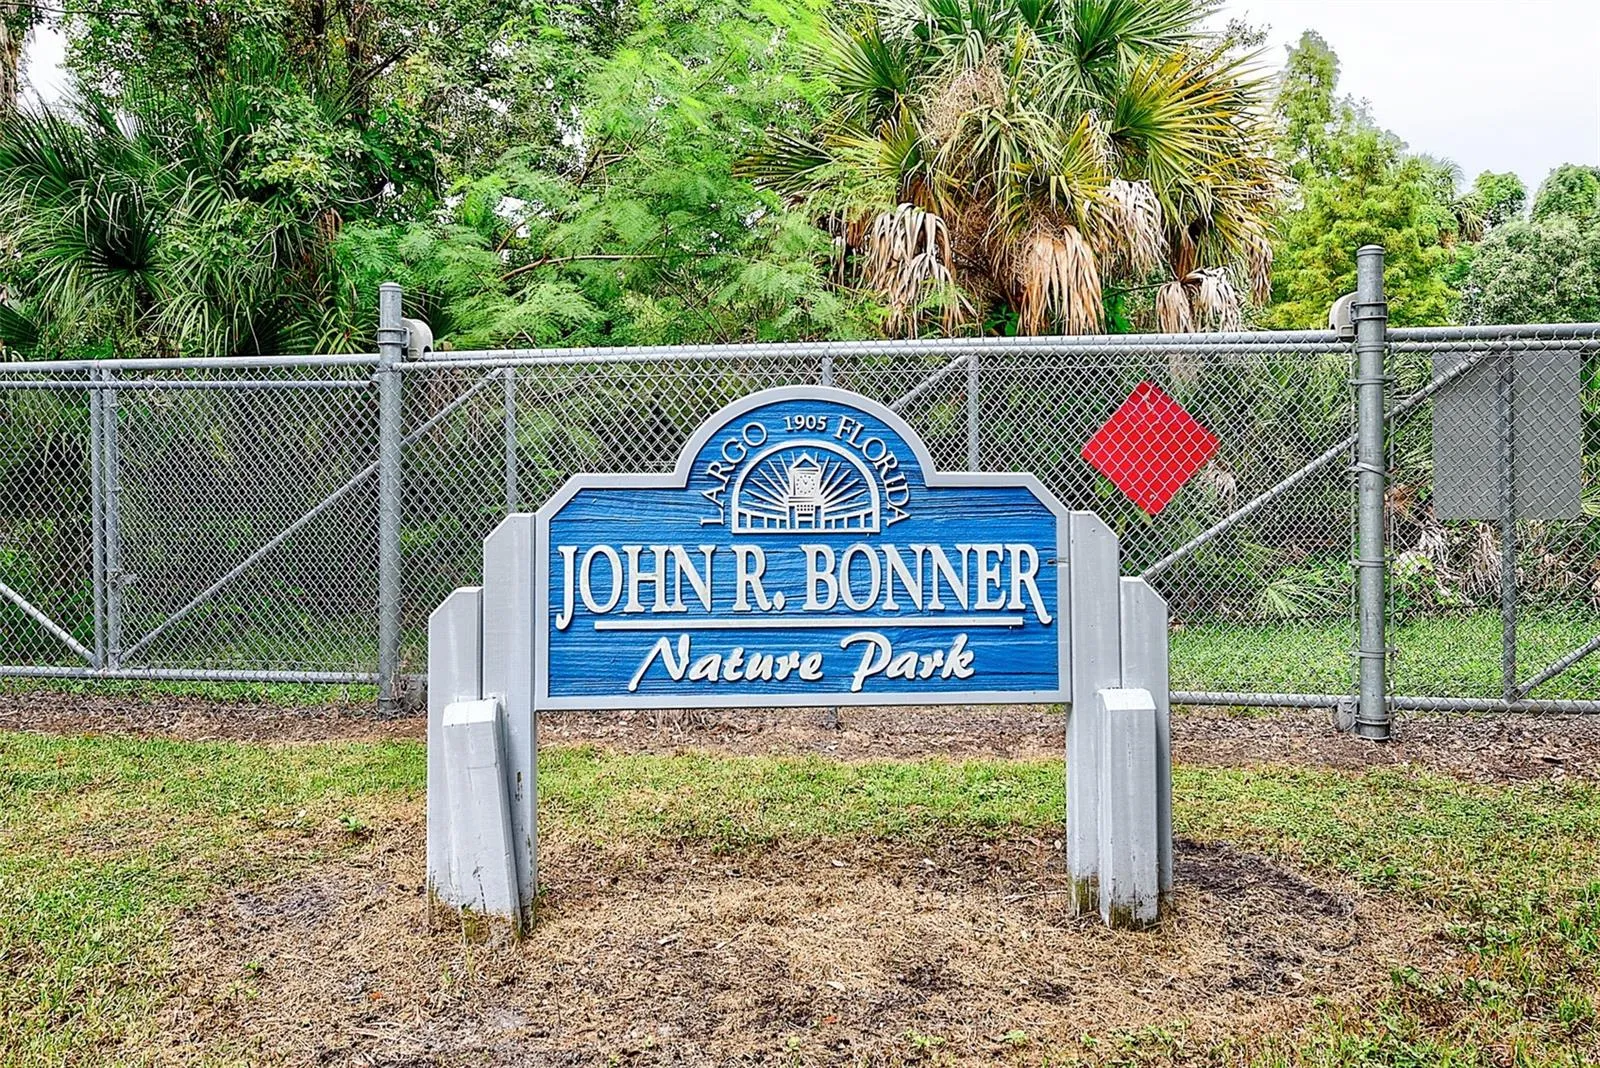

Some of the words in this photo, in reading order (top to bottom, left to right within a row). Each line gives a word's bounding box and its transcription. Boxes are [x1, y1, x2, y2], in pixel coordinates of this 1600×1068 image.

[701, 421, 768, 526] LARGO
[784, 415, 827, 431] 1905
[833, 415, 911, 526] FLORIDA
[555, 544, 717, 630] JOHN
[731, 544, 786, 611] R.
[800, 543, 1052, 625] BONNER
[628, 633, 824, 692] Nature
[840, 632, 975, 692] Park
